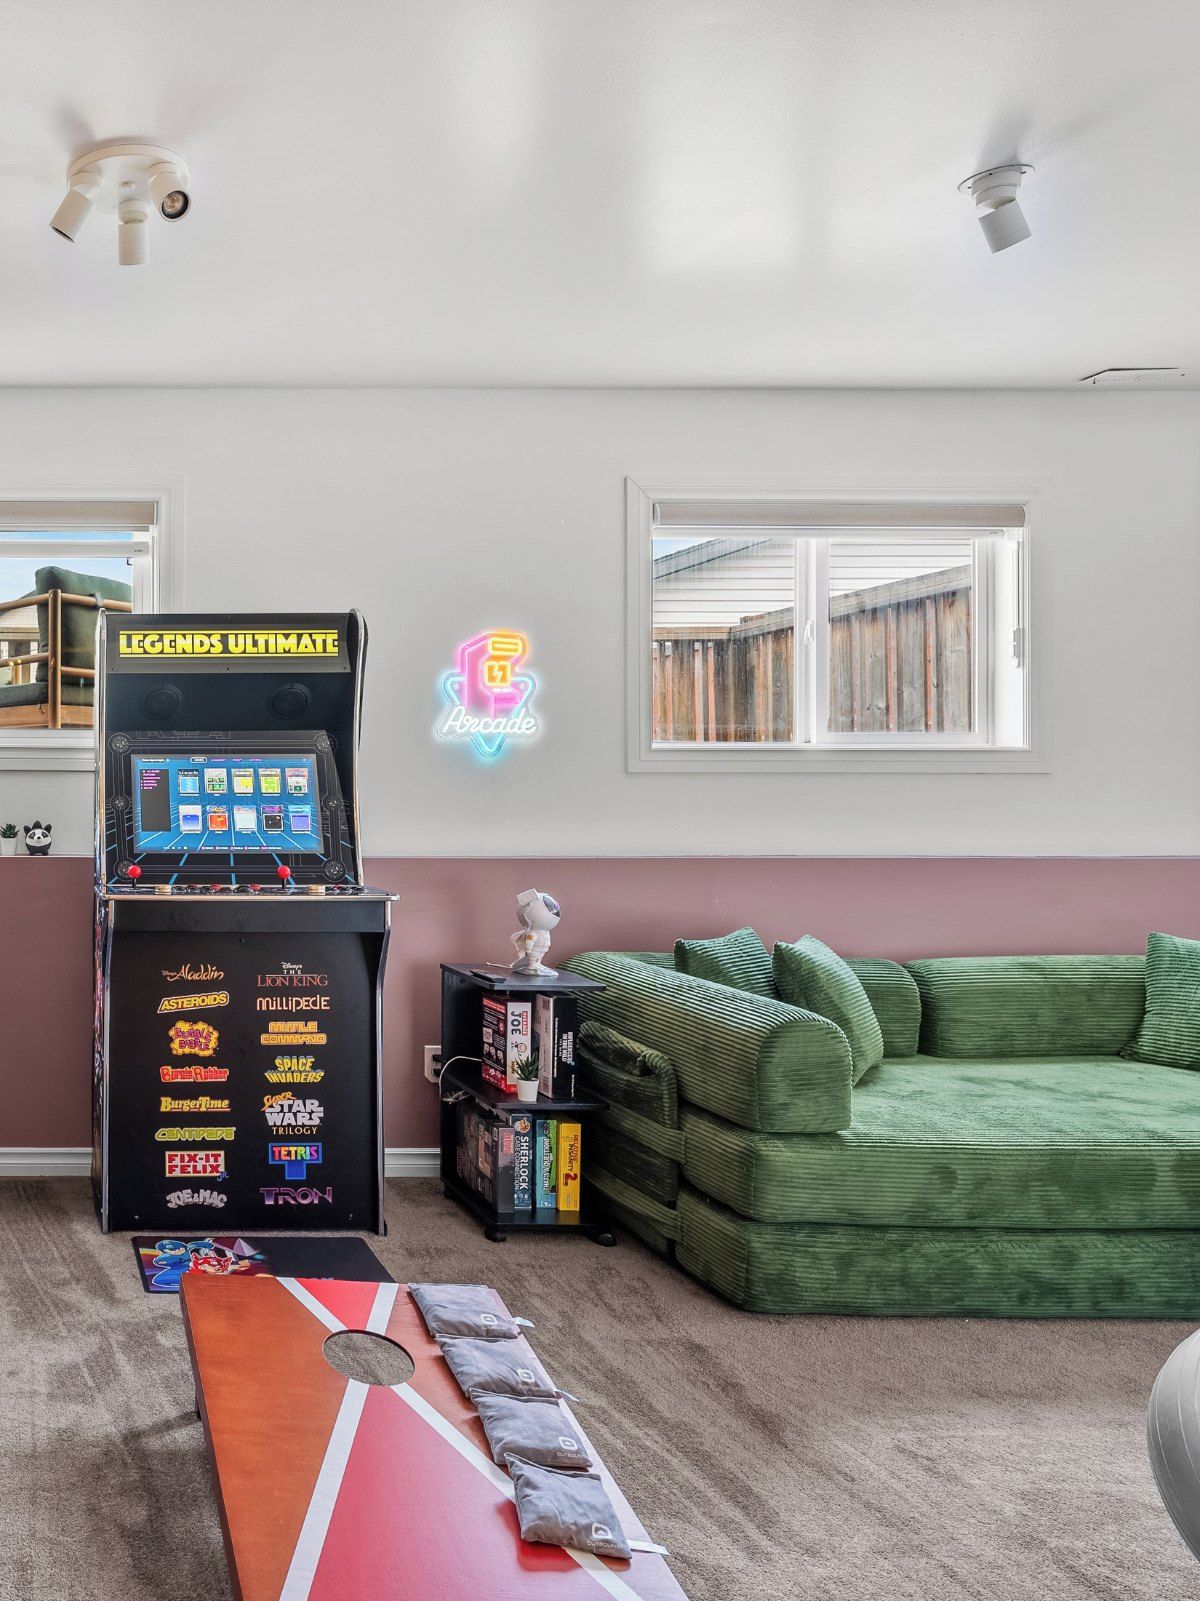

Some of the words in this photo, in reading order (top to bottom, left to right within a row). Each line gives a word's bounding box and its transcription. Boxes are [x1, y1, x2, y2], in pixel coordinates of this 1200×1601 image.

[119, 633, 223, 655] LEGENDS
[227, 633, 339, 655] ULTIMATE
[442, 705, 538, 733] Arcade
[167, 963, 225, 982] Aladdin
[257, 974, 289, 987] LION
[293, 974, 329, 987] KING
[159, 993, 228, 1011] ASTEROIDS
[511, 1011, 521, 1036] JOE
[261, 1033, 327, 1045] COMMAND
[275, 1056, 316, 1071] SPACE
[264, 1070, 325, 1083] INVADERS
[160, 1097, 230, 1112] BurgerTime
[260, 1091, 297, 1111] SUPER
[265, 1099, 324, 1113] STAR
[265, 1112, 324, 1126] WARS
[155, 1127, 235, 1141] CENTIPEDE
[272, 1126, 318, 1135] TRILOGY
[167, 1153, 222, 1164] FIX-IT
[273, 1146, 319, 1161] TETRIS
[167, 1164, 221, 1175] FELIX
[519, 1136, 529, 1190] SHERLOCK
[165, 1189, 193, 1209] JOE
[193, 1193, 200, 1205] &
[199, 1188, 228, 1209] MAC
[260, 1186, 333, 1205] TRON
